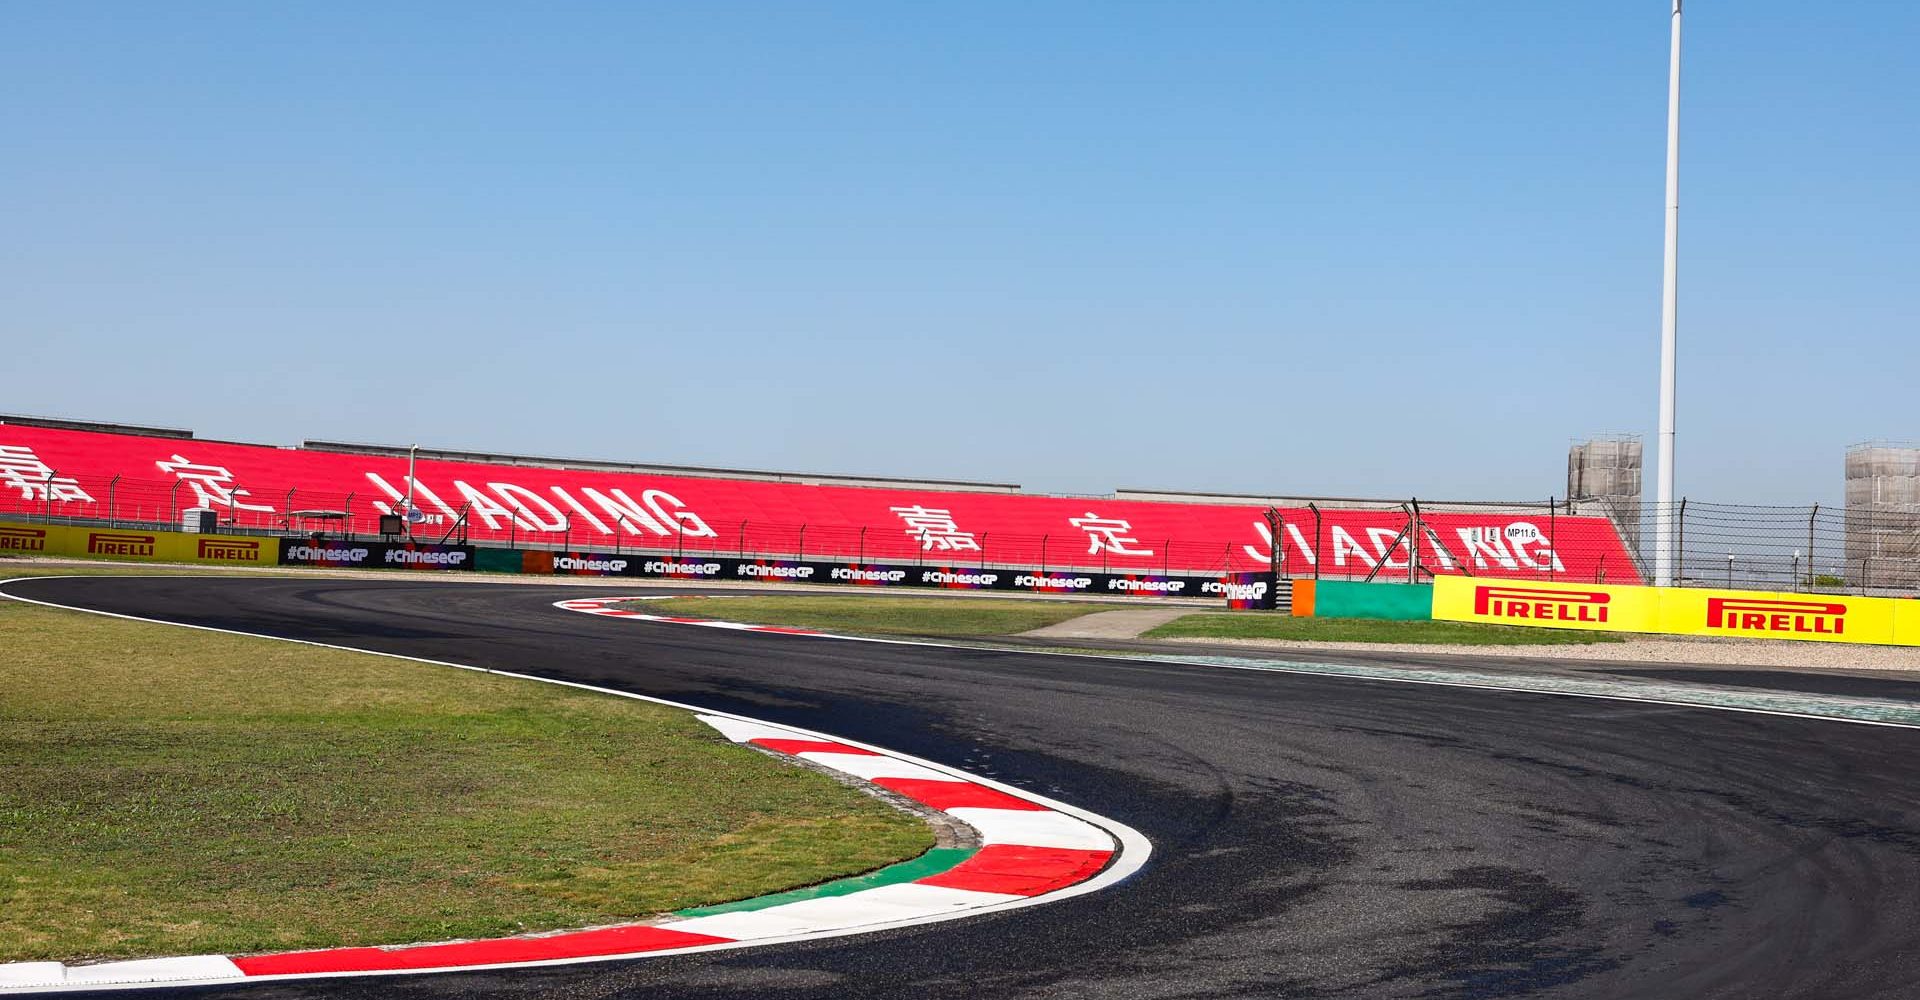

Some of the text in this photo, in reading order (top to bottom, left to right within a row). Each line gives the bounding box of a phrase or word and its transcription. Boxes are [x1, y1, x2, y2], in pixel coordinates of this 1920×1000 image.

[365, 472, 718, 538] JIADING
[0, 527, 46, 550] RELLI
[1507, 528, 1536, 538] MP11.6
[88, 533, 155, 557] PIRELLI
[198, 539, 259, 561] PIRELLI
[1243, 521, 1565, 572] JIADING
[287, 545, 368, 561] #ChineseGP
[385, 549, 466, 564] #ChineseGP
[644, 561, 720, 575] #ChineseGP
[737, 563, 814, 578] #ChineseGP
[831, 567, 905, 582] #ChineseGP
[922, 571, 998, 586] #ChineseGP
[1014, 575, 1091, 589] #ChineseGP
[1108, 578, 1185, 592] #ChineseGP
[1474, 586, 1611, 623] PIRELLI
[1707, 598, 1847, 634] PIRELLI
